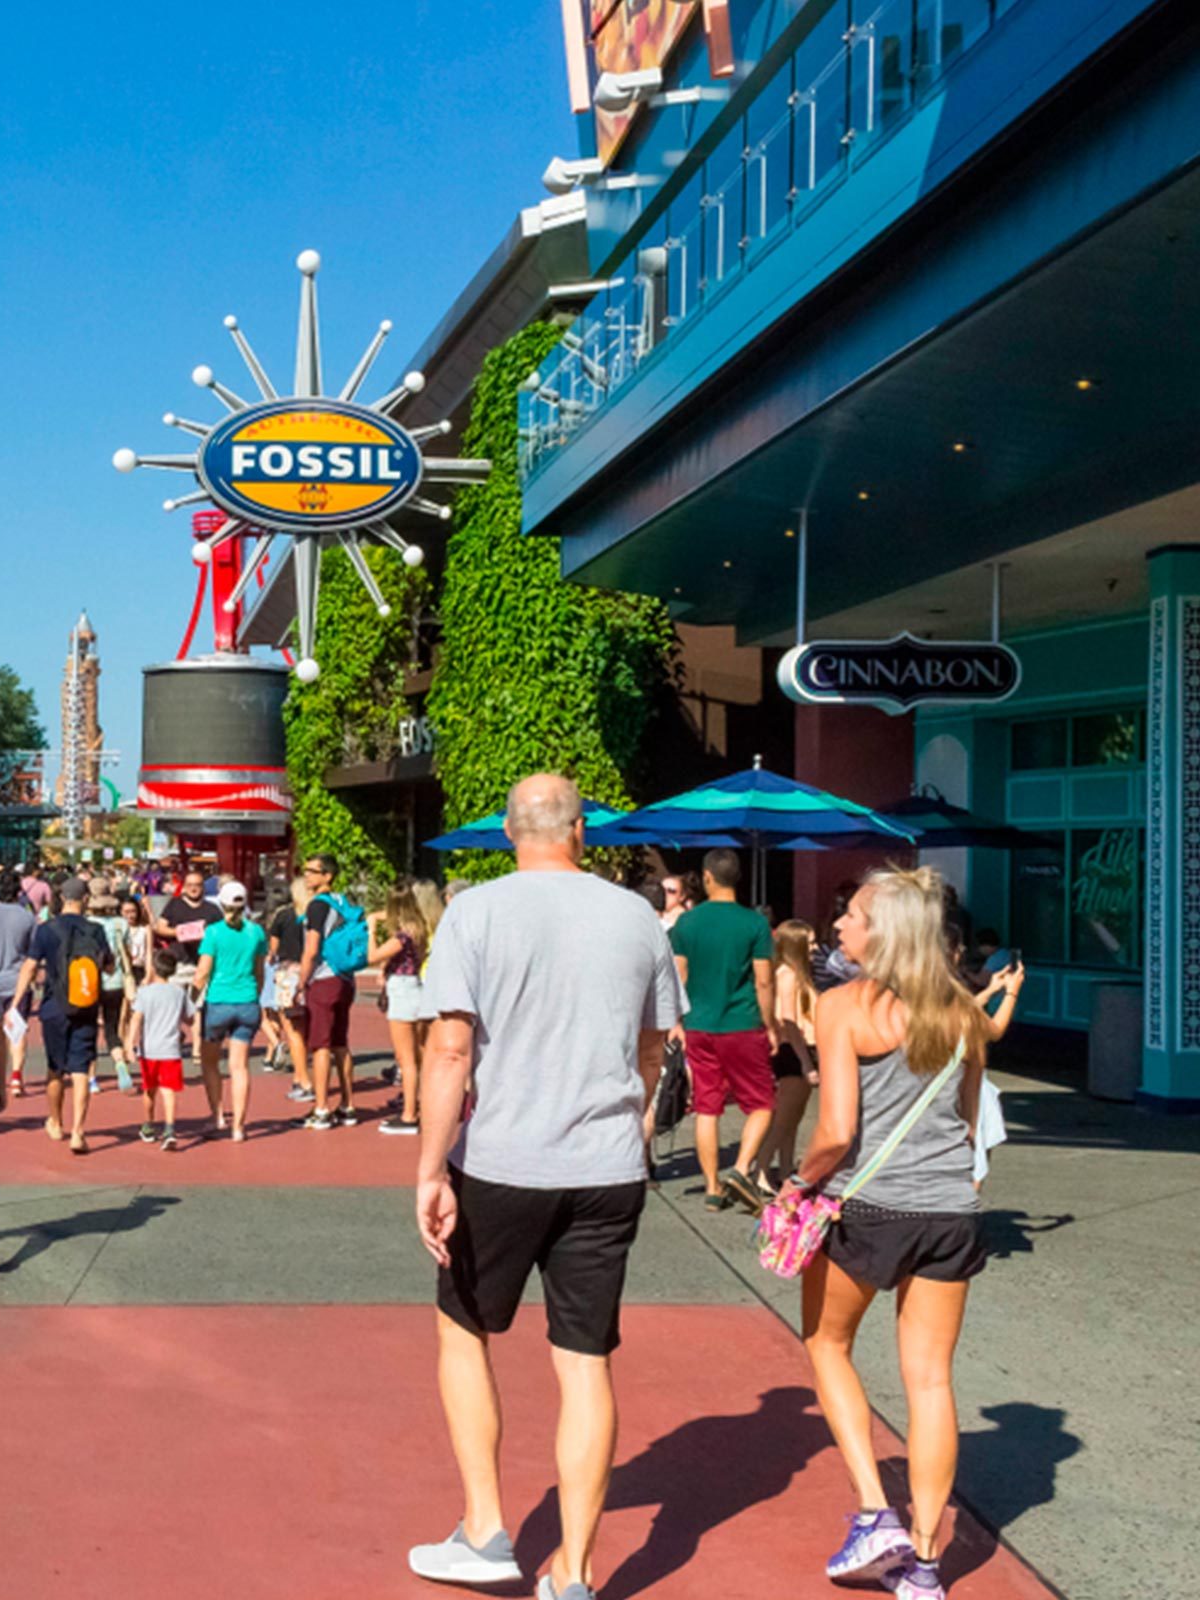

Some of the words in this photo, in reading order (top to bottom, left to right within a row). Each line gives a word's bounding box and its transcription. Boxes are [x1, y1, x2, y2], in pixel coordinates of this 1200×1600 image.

[231, 444, 402, 480] FOSSIL
[808, 653, 1002, 688] CINNABON
[399, 716, 434, 757] FOS
